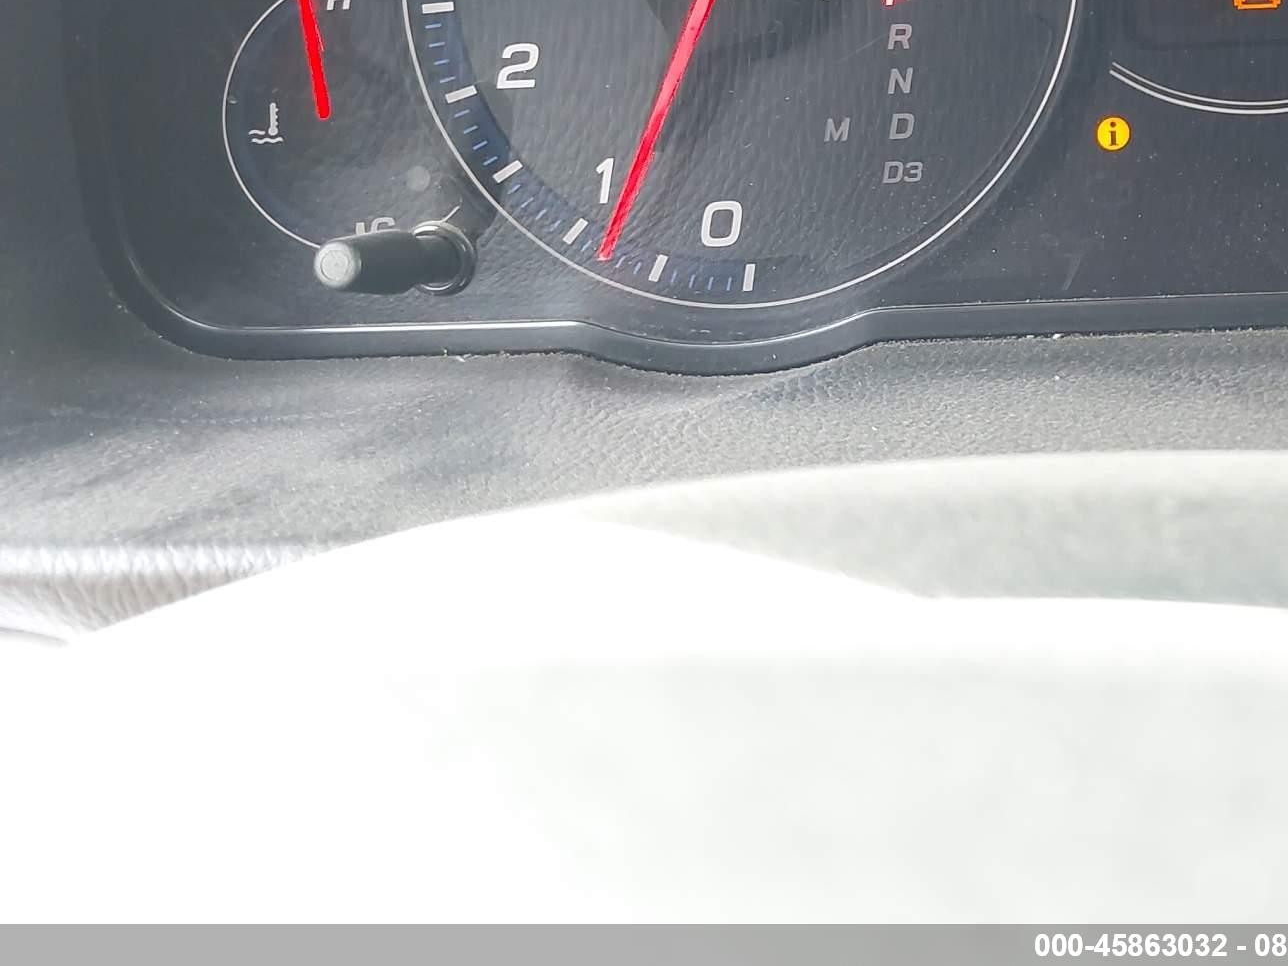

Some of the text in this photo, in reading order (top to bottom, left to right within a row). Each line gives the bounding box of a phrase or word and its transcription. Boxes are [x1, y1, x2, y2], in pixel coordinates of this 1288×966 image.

[887, 24, 912, 49] R
[496, 43, 541, 89] 2
[887, 68, 913, 93] N
[824, 117, 850, 142] M
[888, 114, 915, 139] D
[595, 157, 615, 203] 1
[882, 160, 923, 184] D3
[701, 200, 743, 247] 0
